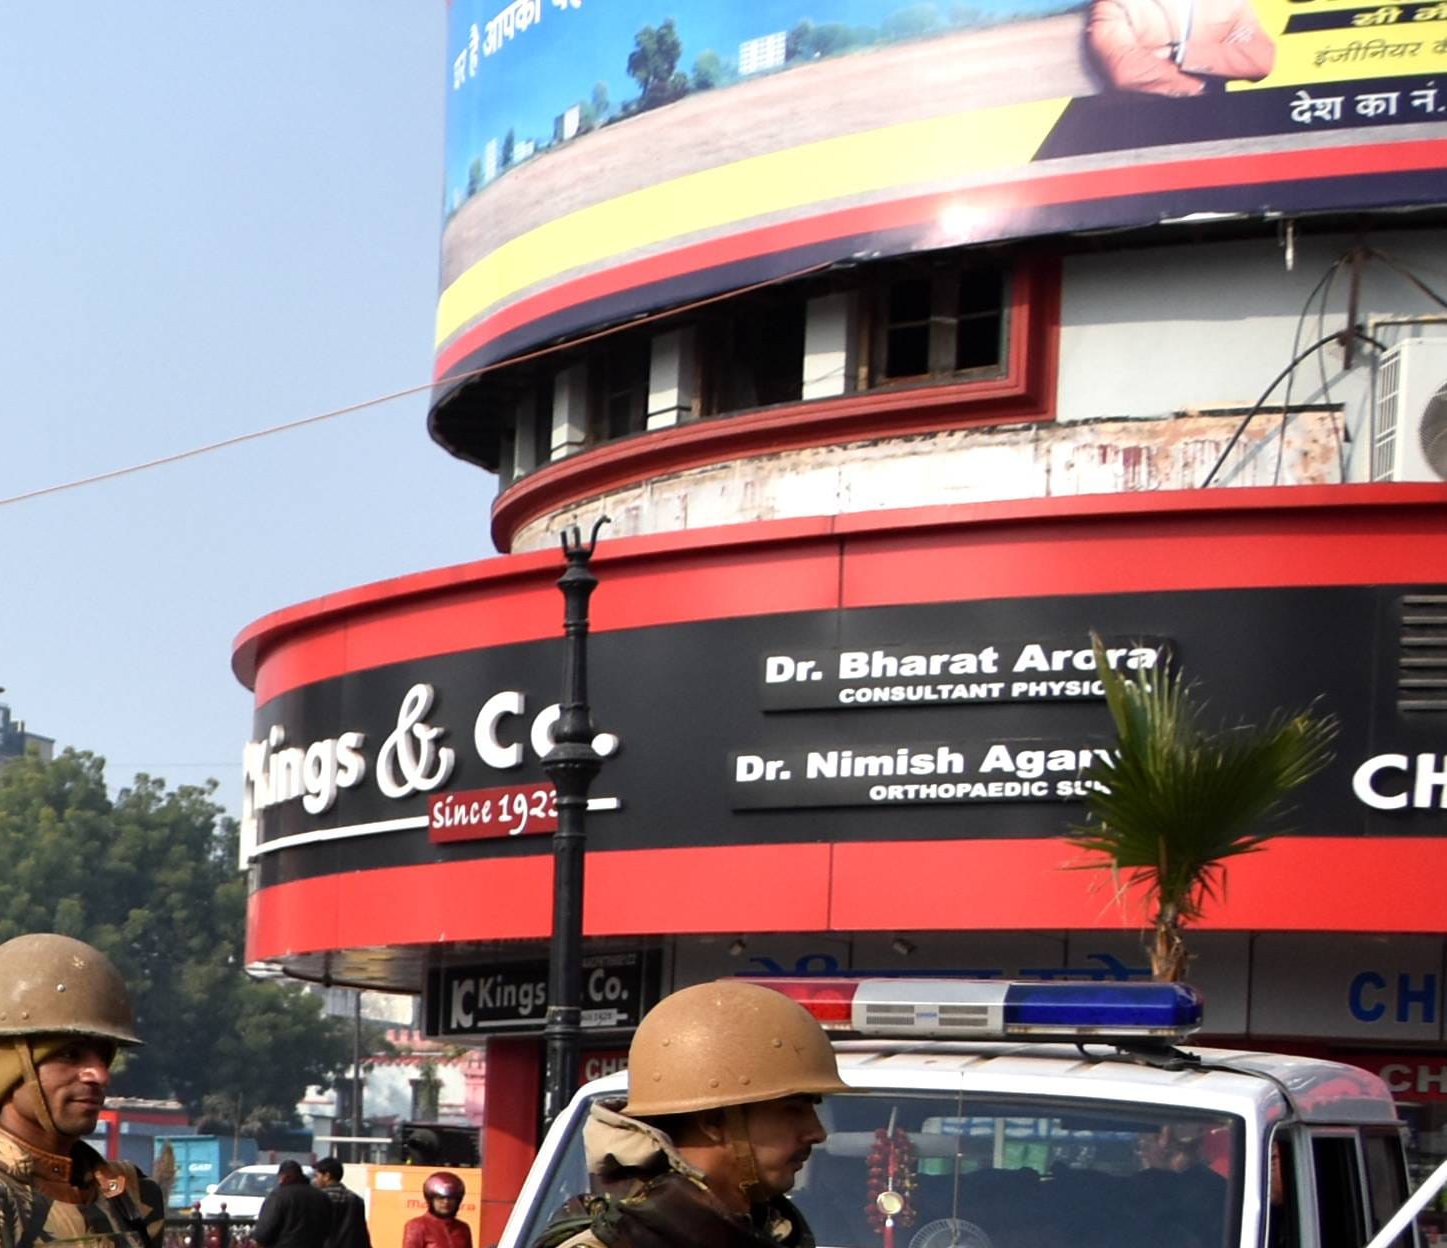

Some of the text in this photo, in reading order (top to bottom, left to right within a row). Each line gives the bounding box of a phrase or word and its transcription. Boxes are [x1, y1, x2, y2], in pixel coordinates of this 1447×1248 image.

[1290, 90, 1345, 123] देश
[1355, 92, 1400, 116] का
[766, 644, 1159, 684] Dr. Bharat Arora
[839, 680, 1152, 704] CONSULTANT PHYSIC
[736, 755, 791, 783] Dr.
[806, 747, 965, 780] Nimish
[869, 781, 1049, 801] ORTHOPAEDIC
[477, 974, 546, 1016] Kings
[588, 967, 629, 1002] Co.
[1348, 970, 1437, 1024] CH
